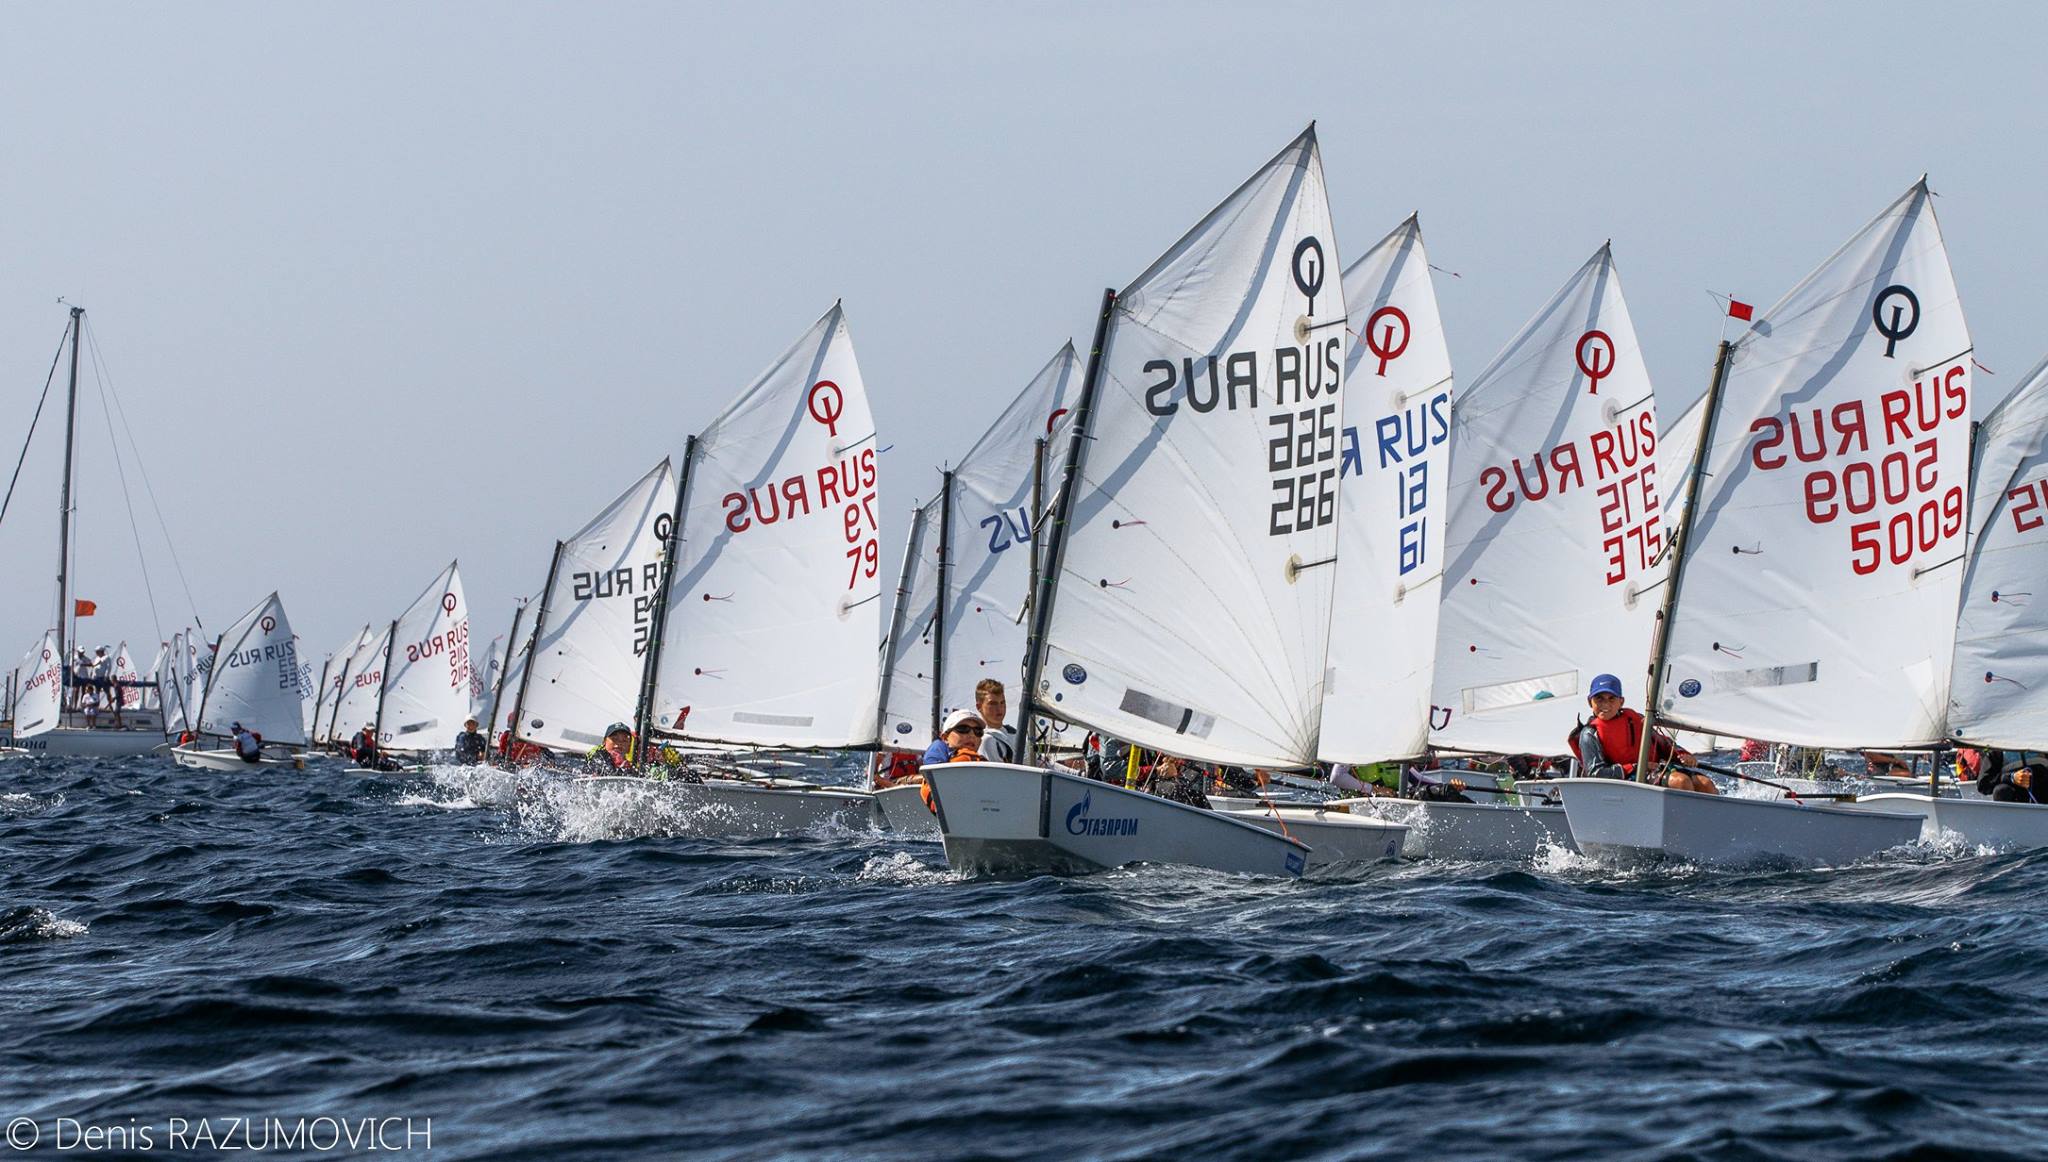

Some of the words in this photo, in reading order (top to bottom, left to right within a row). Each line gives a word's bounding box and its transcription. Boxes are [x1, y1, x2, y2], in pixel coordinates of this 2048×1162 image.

[1275, 337, 1340, 405] RUS
[1881, 365, 1966, 445] RUS
[1376, 393, 1448, 469] RUS
[1590, 411, 1656, 480] RUS
[817, 448, 876, 509] RUS
[1269, 467, 1336, 537] 266
[847, 538, 878, 590] 79
[1399, 516, 1426, 576] 61
[1603, 515, 1661, 586] 375
[1850, 485, 1963, 576] 5009
[265, 641, 295, 661] RUS
[447, 621, 468, 649] RUS
